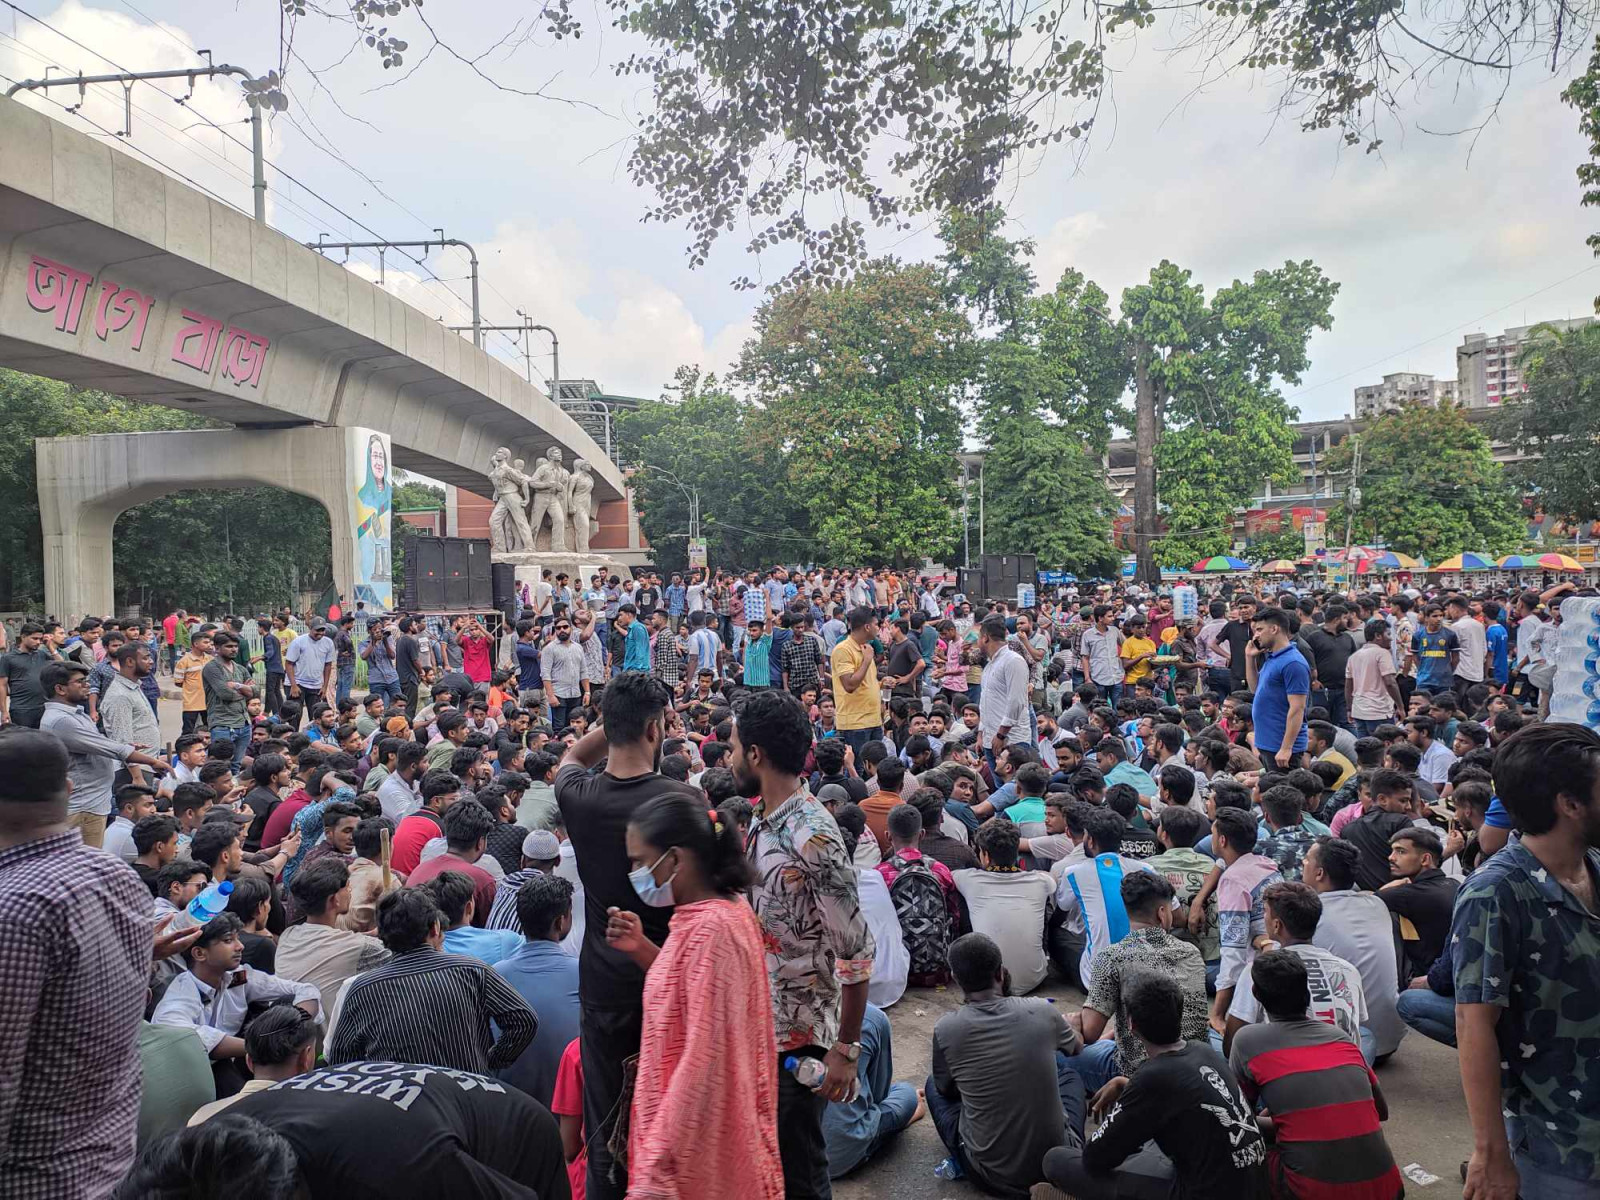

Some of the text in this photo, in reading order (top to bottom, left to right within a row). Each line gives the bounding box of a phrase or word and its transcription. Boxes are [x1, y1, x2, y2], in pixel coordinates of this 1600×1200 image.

[26, 254, 155, 352] আগে
[1120, 840, 1155, 854] EEDOM
[1303, 959, 1333, 1003] BORN
[267, 1073, 423, 1111] WISH
